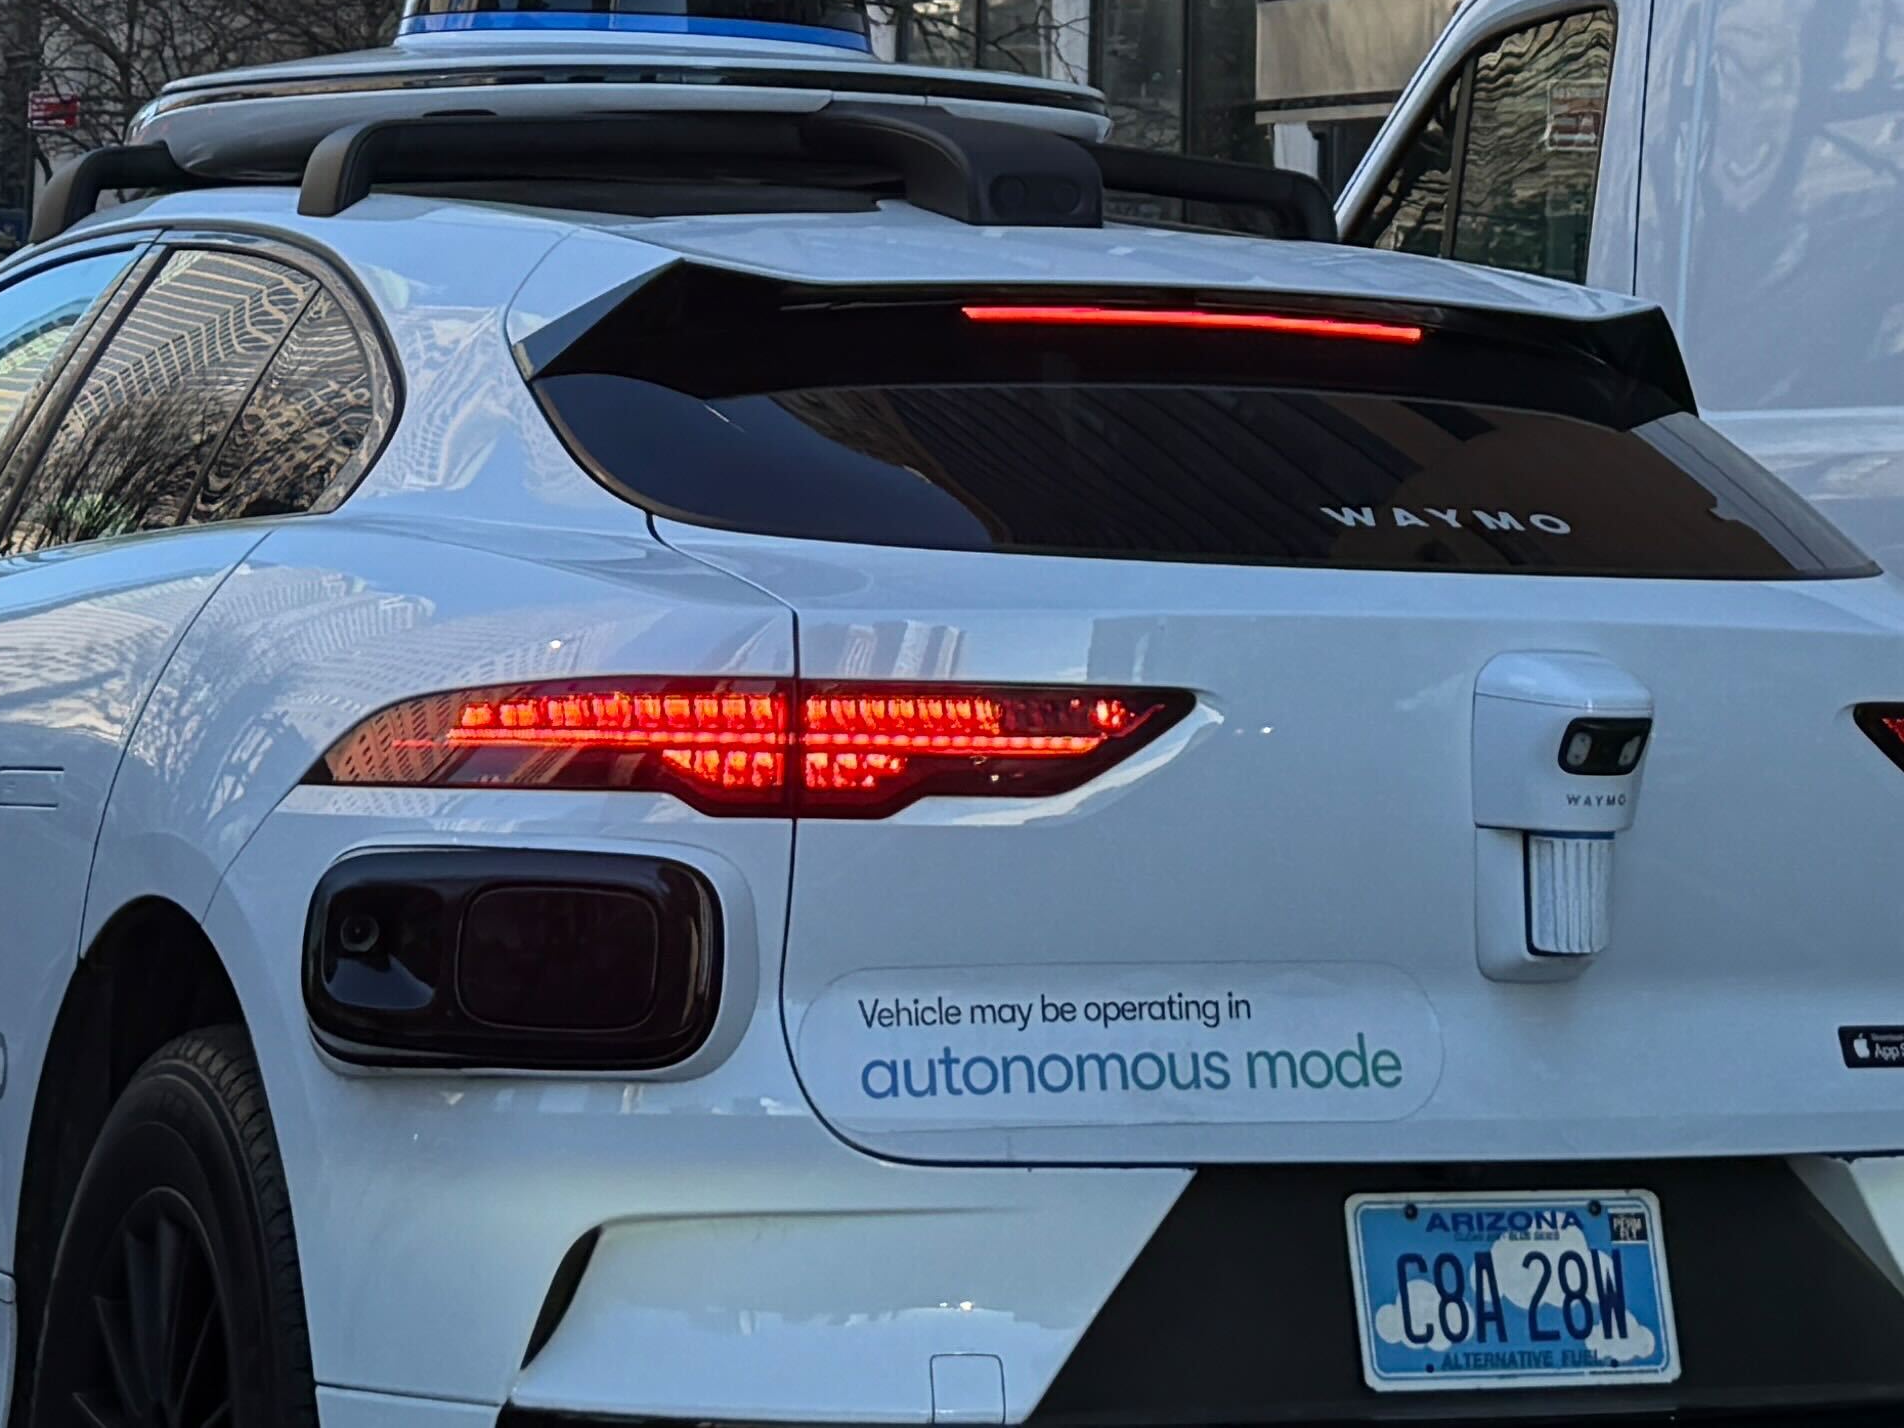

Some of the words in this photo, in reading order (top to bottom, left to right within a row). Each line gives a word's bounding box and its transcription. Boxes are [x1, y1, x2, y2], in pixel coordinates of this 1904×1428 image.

[1319, 506, 1572, 535] WAYMO
[1565, 793, 1627, 807] WAYMO
[857, 997, 962, 1029] Vehicle
[969, 999, 1033, 1031] may
[1040, 994, 1077, 1023] be
[1083, 992, 1221, 1029] operating
[1226, 991, 1252, 1021] in
[1874, 1043, 1900, 1061] App
[860, 1045, 1232, 1100] autonomous
[1246, 1032, 1403, 1090] mode
[1425, 1210, 1585, 1233] ARIZONA
[1397, 1251, 1508, 1344] C8A
[1521, 1247, 1629, 1341] 28W
[1441, 1350, 1552, 1371] ALTERNATIVE
[1561, 1349, 1604, 1368] FUEL
